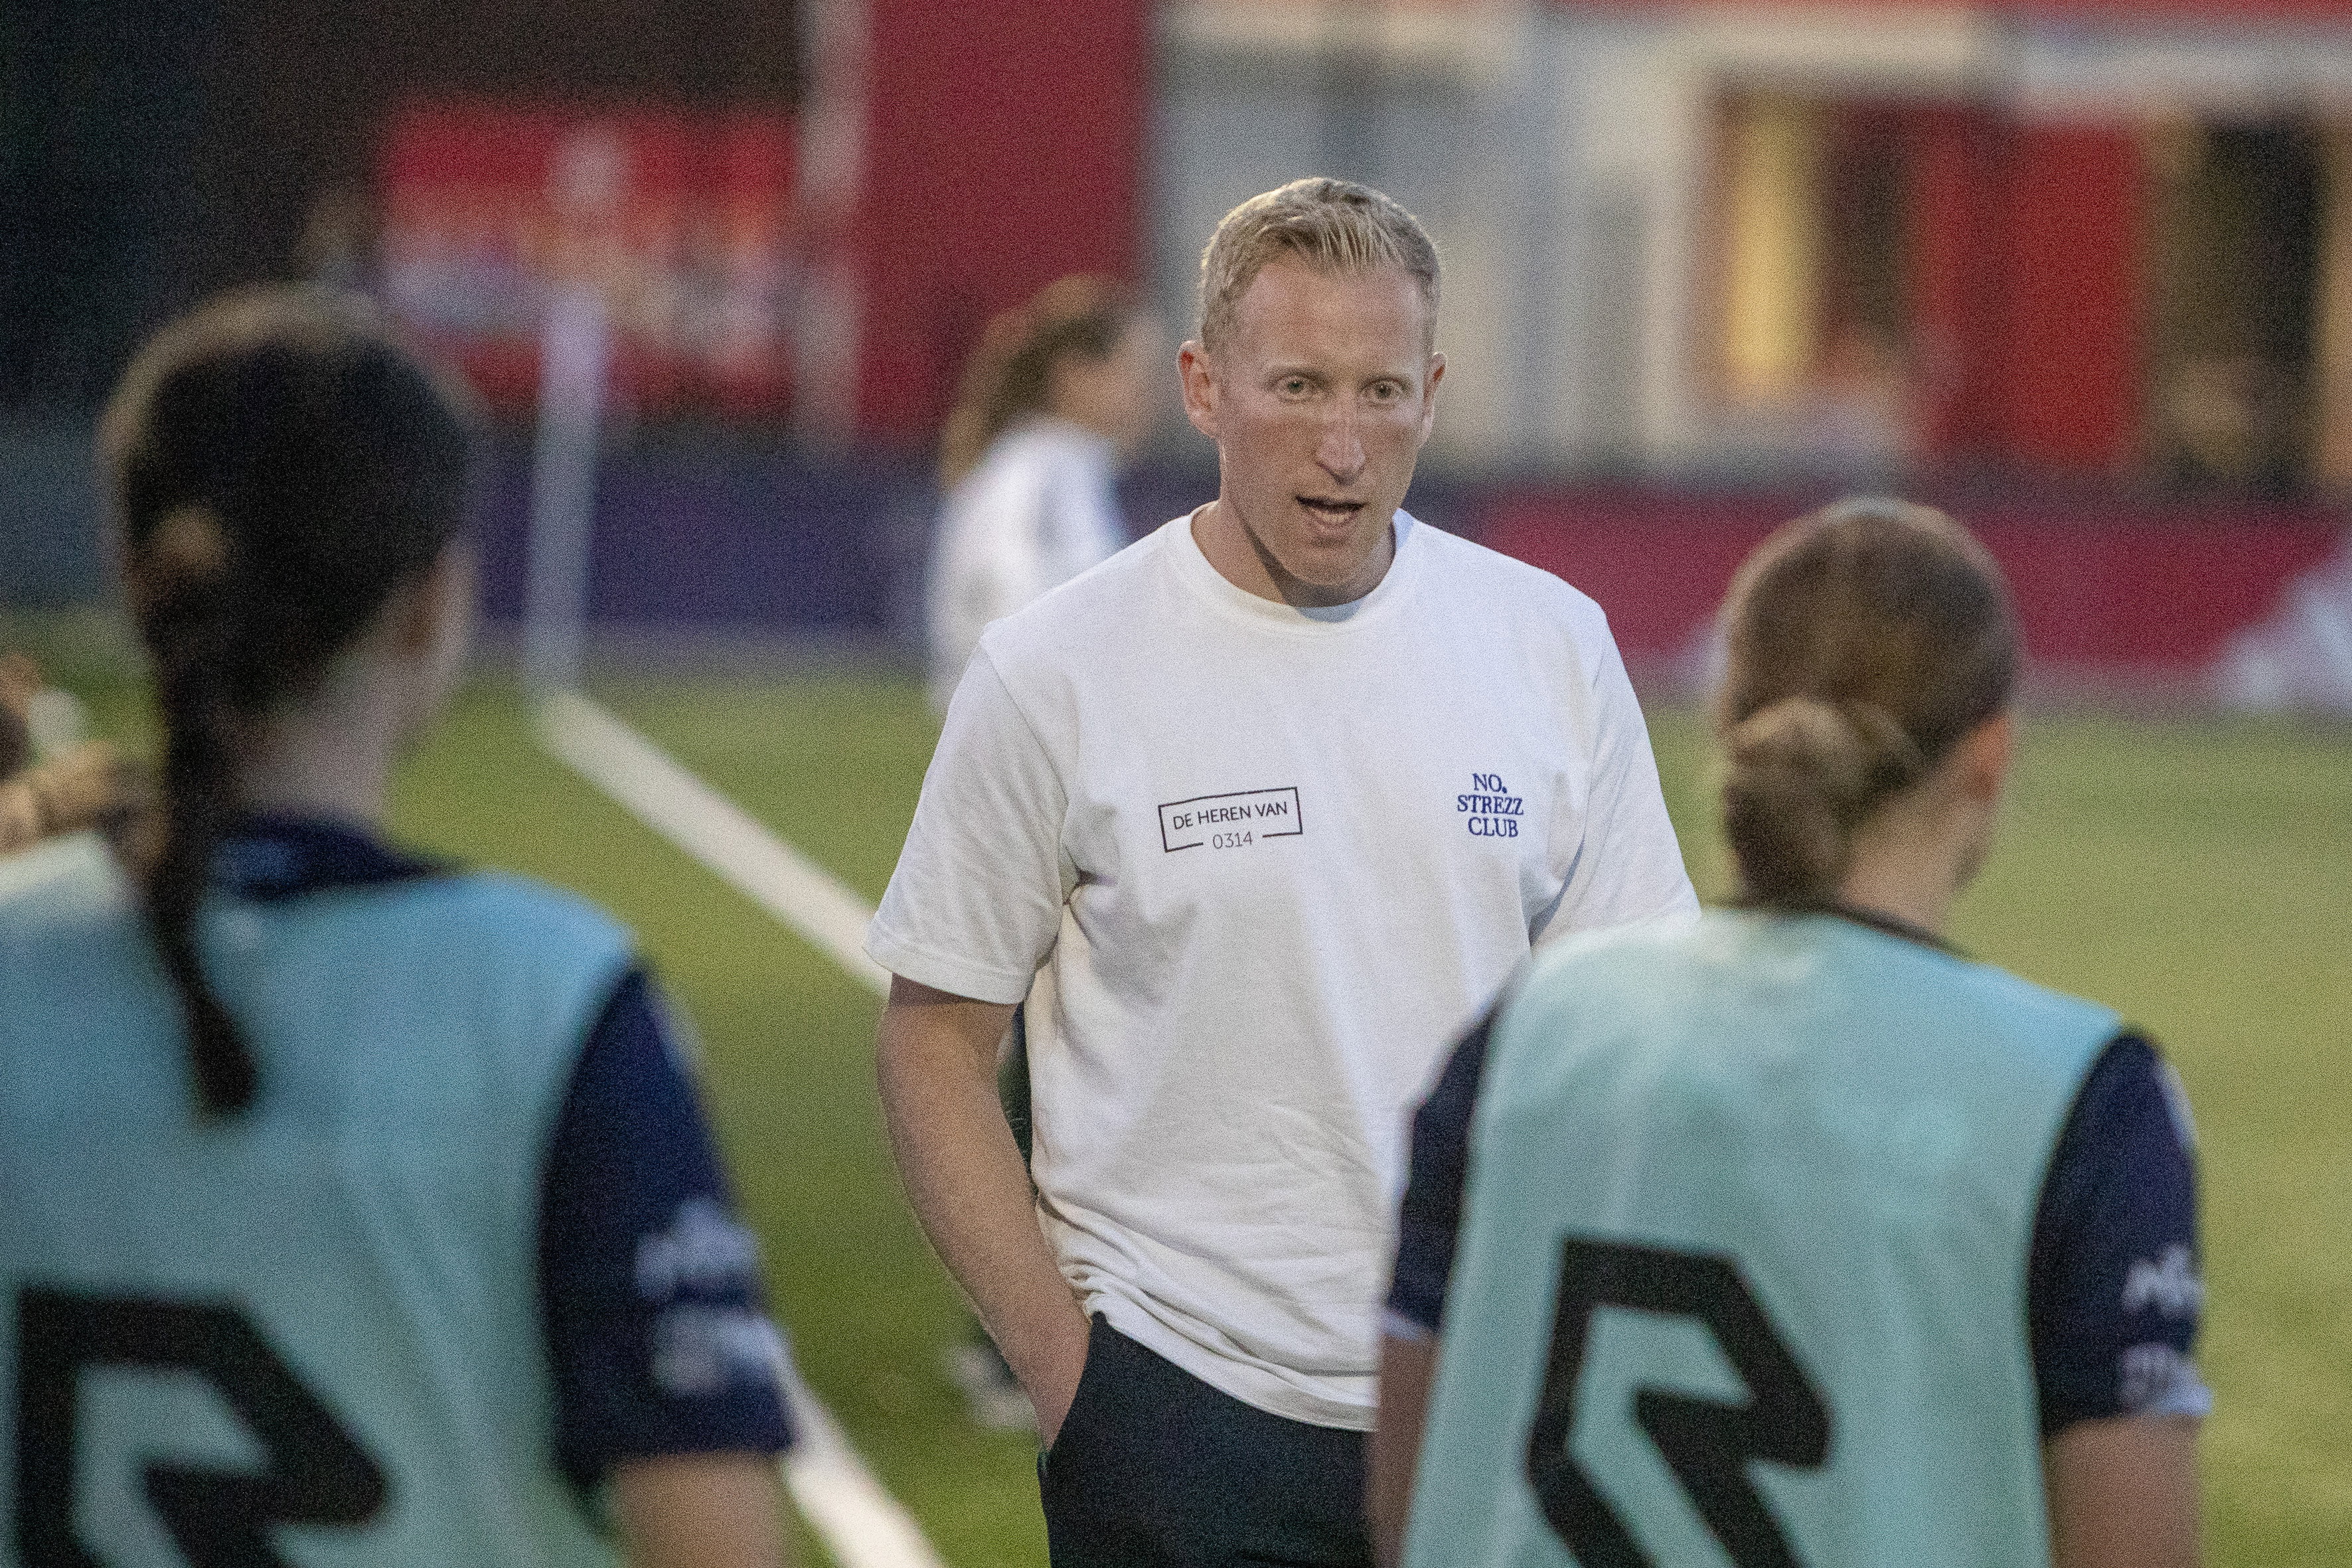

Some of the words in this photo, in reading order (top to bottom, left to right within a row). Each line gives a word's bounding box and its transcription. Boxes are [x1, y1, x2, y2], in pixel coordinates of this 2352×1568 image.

[1472, 773, 1508, 793] NO.
[1456, 794, 1524, 815] STREZZ
[1172, 813, 1194, 830] DE
[1197, 805, 1252, 825] HEREN
[1255, 801, 1288, 817] VAN
[1468, 817, 1519, 838] CLUB
[1212, 831, 1254, 850] 0314
